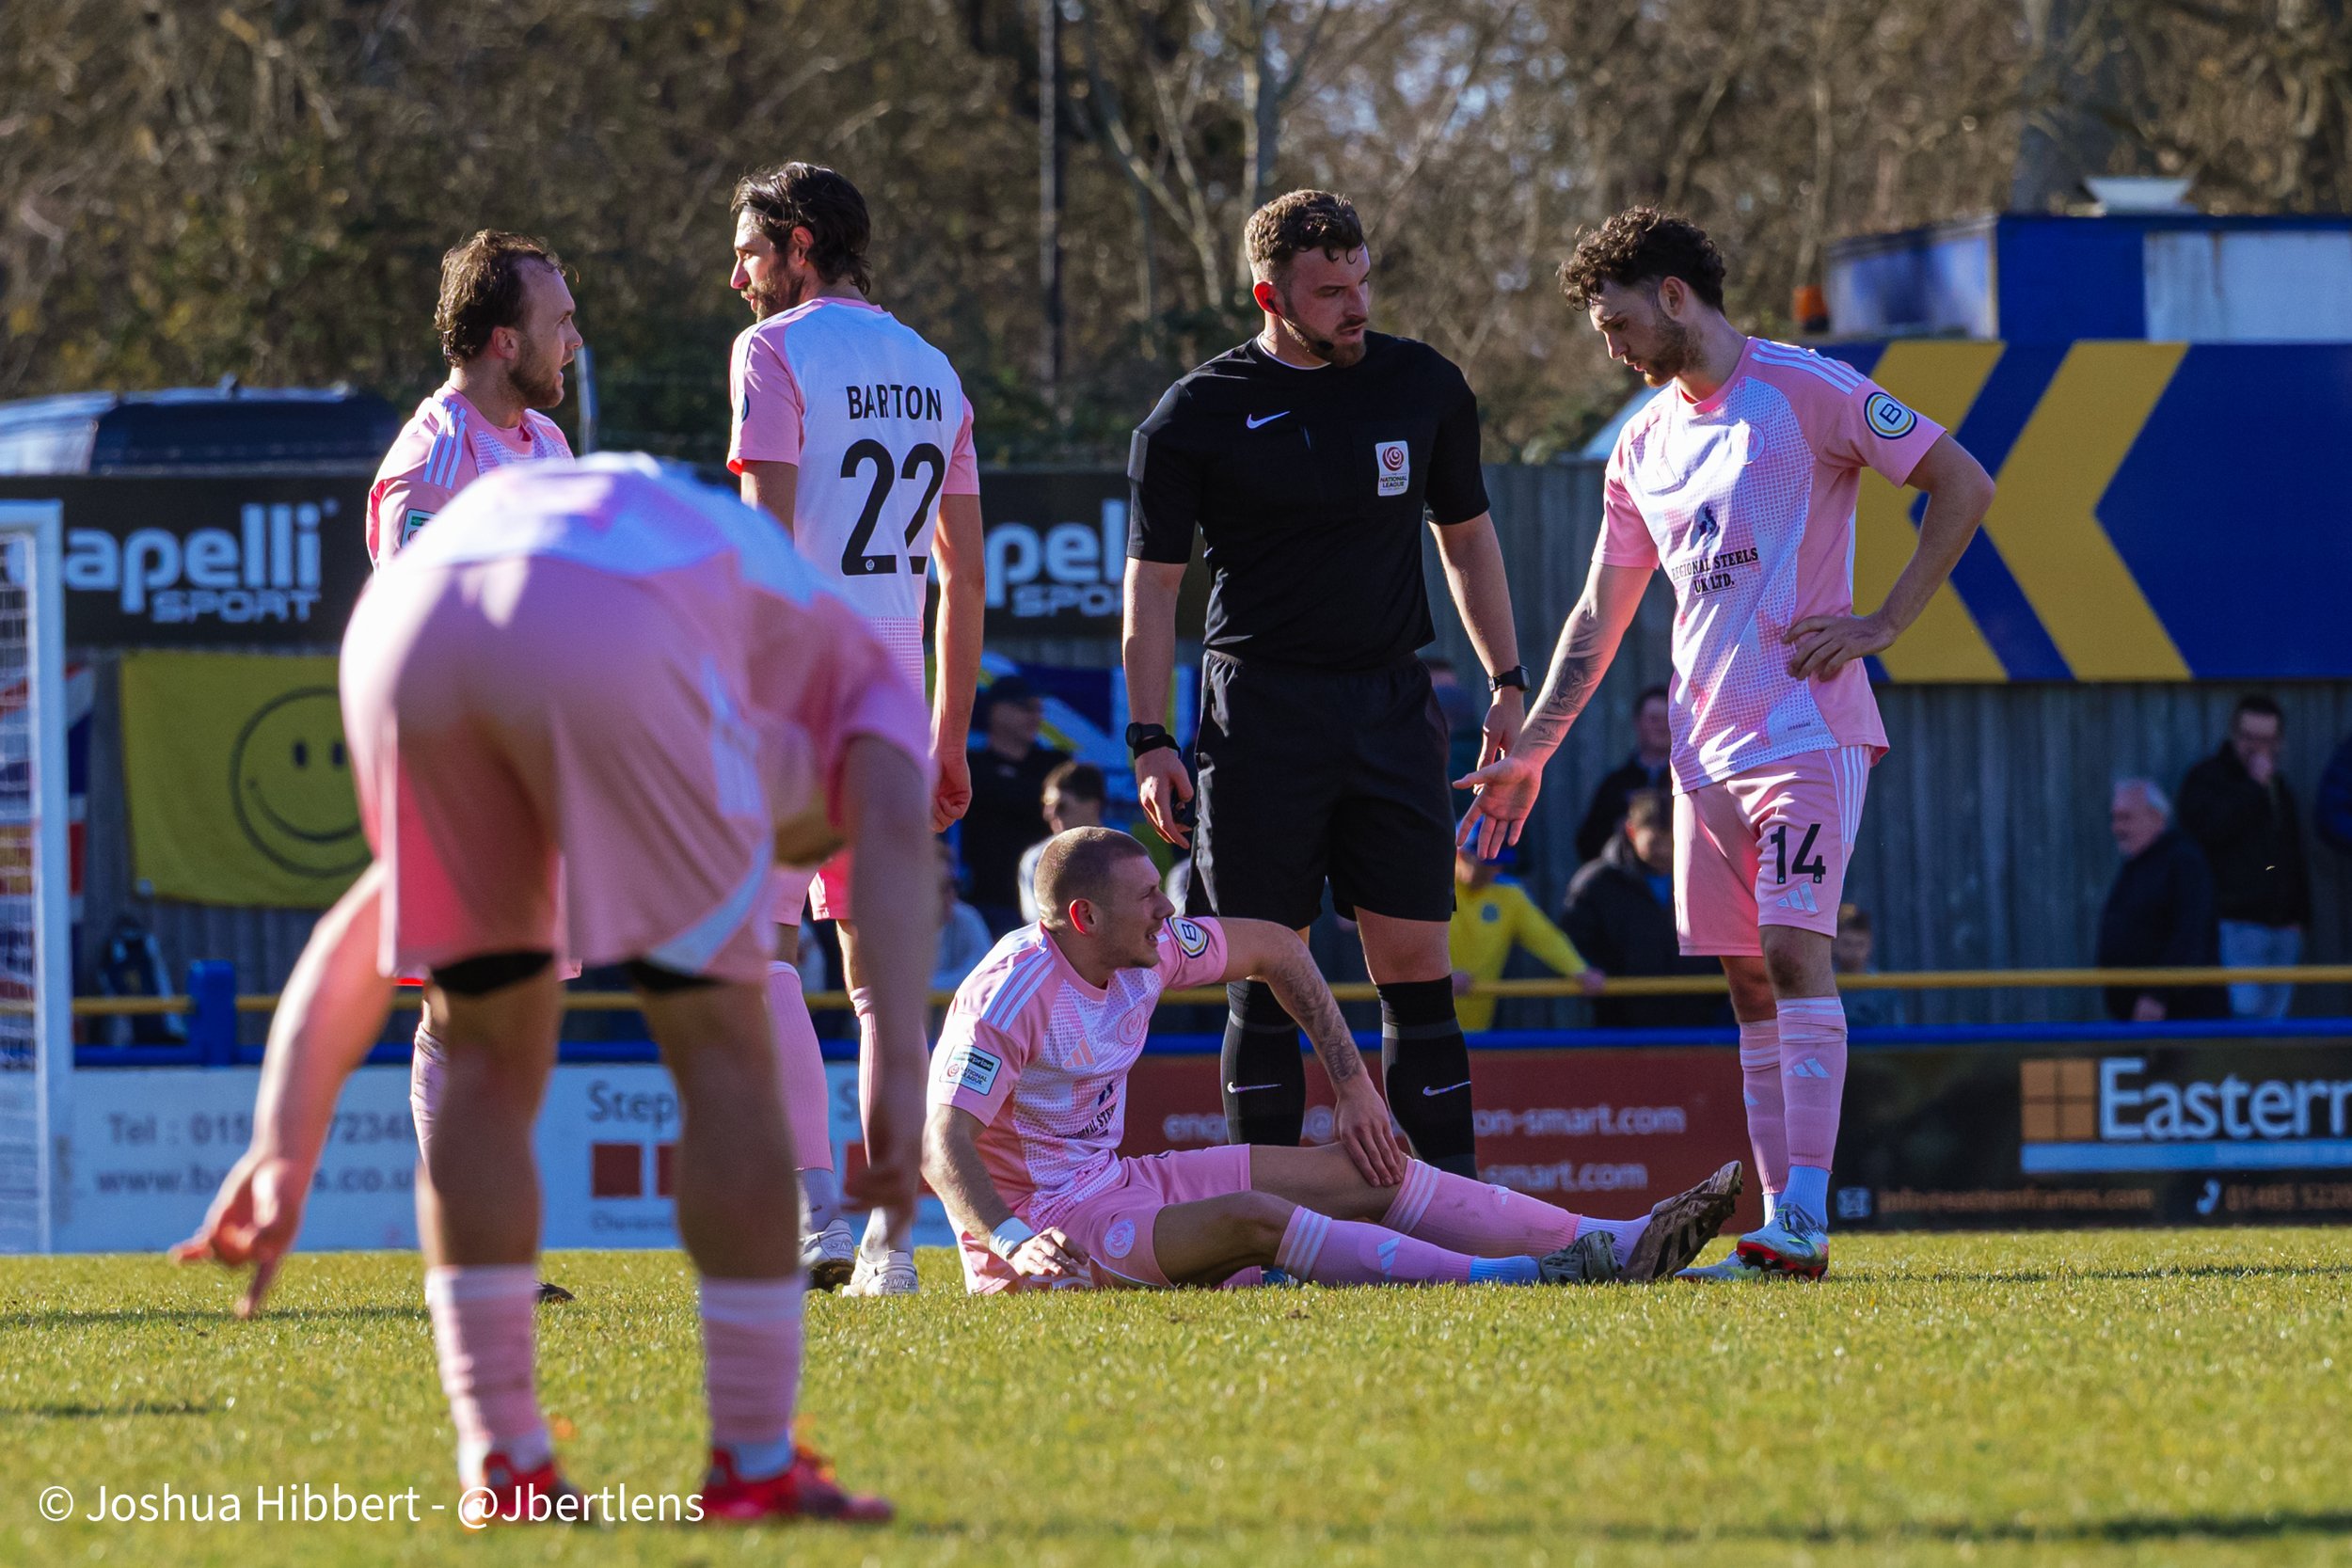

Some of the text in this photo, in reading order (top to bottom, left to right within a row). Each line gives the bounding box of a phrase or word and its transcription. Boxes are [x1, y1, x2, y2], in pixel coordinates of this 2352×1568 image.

[846, 384, 943, 421] BARTON
[1879, 403, 1902, 425] B
[840, 438, 946, 577] 22
[1671, 546, 1759, 581] REGIONAL STEELS
[1010, 583, 1123, 617] SPO
[1693, 573, 1735, 594] UK LTD.
[150, 588, 321, 624] SPORT
[1771, 823, 1826, 885] 14
[1181, 923, 1198, 942] B
[587, 1078, 675, 1129] Step
[107, 1112, 158, 1144] Tel
